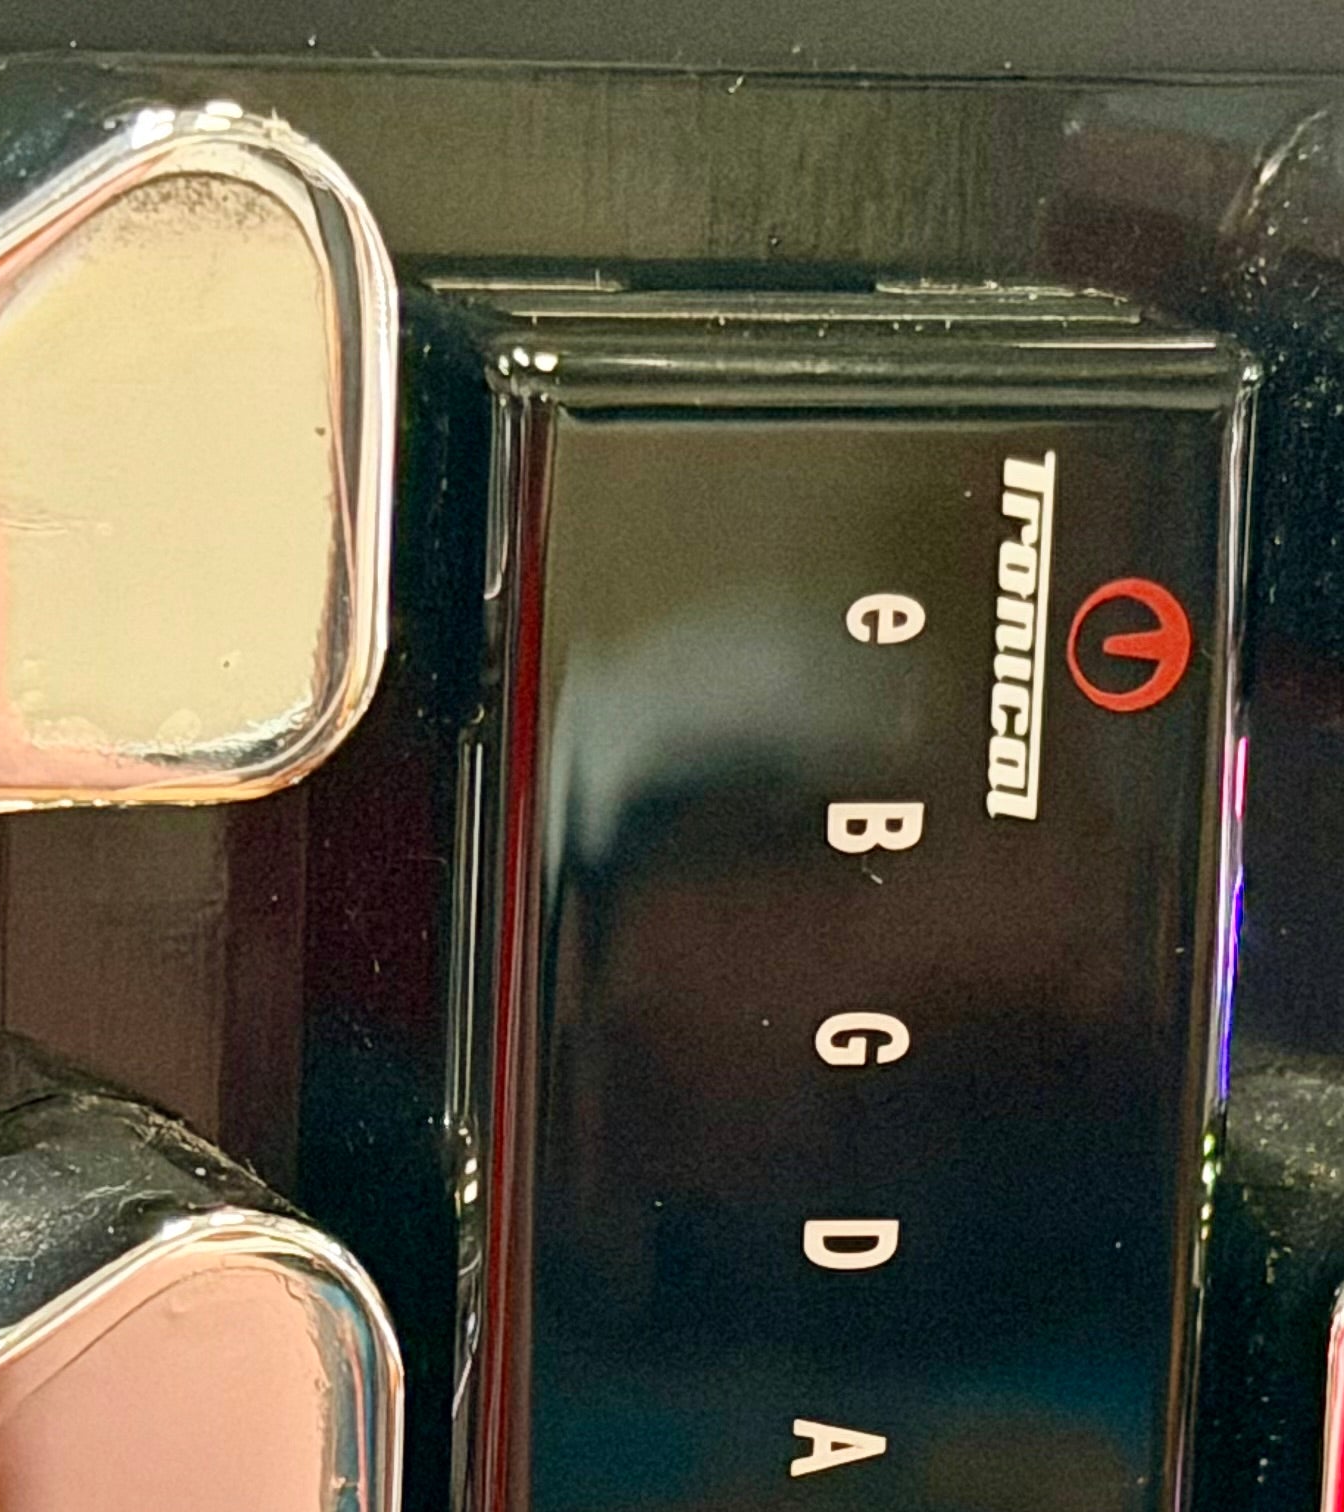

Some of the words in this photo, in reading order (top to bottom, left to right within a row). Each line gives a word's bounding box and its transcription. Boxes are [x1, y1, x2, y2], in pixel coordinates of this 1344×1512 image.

[845, 592, 926, 645] e
[986, 449, 1057, 820] Tronical
[827, 802, 925, 854] B
[815, 1011, 910, 1066] G
[803, 1219, 900, 1270] D
[790, 1418, 887, 1477] A
